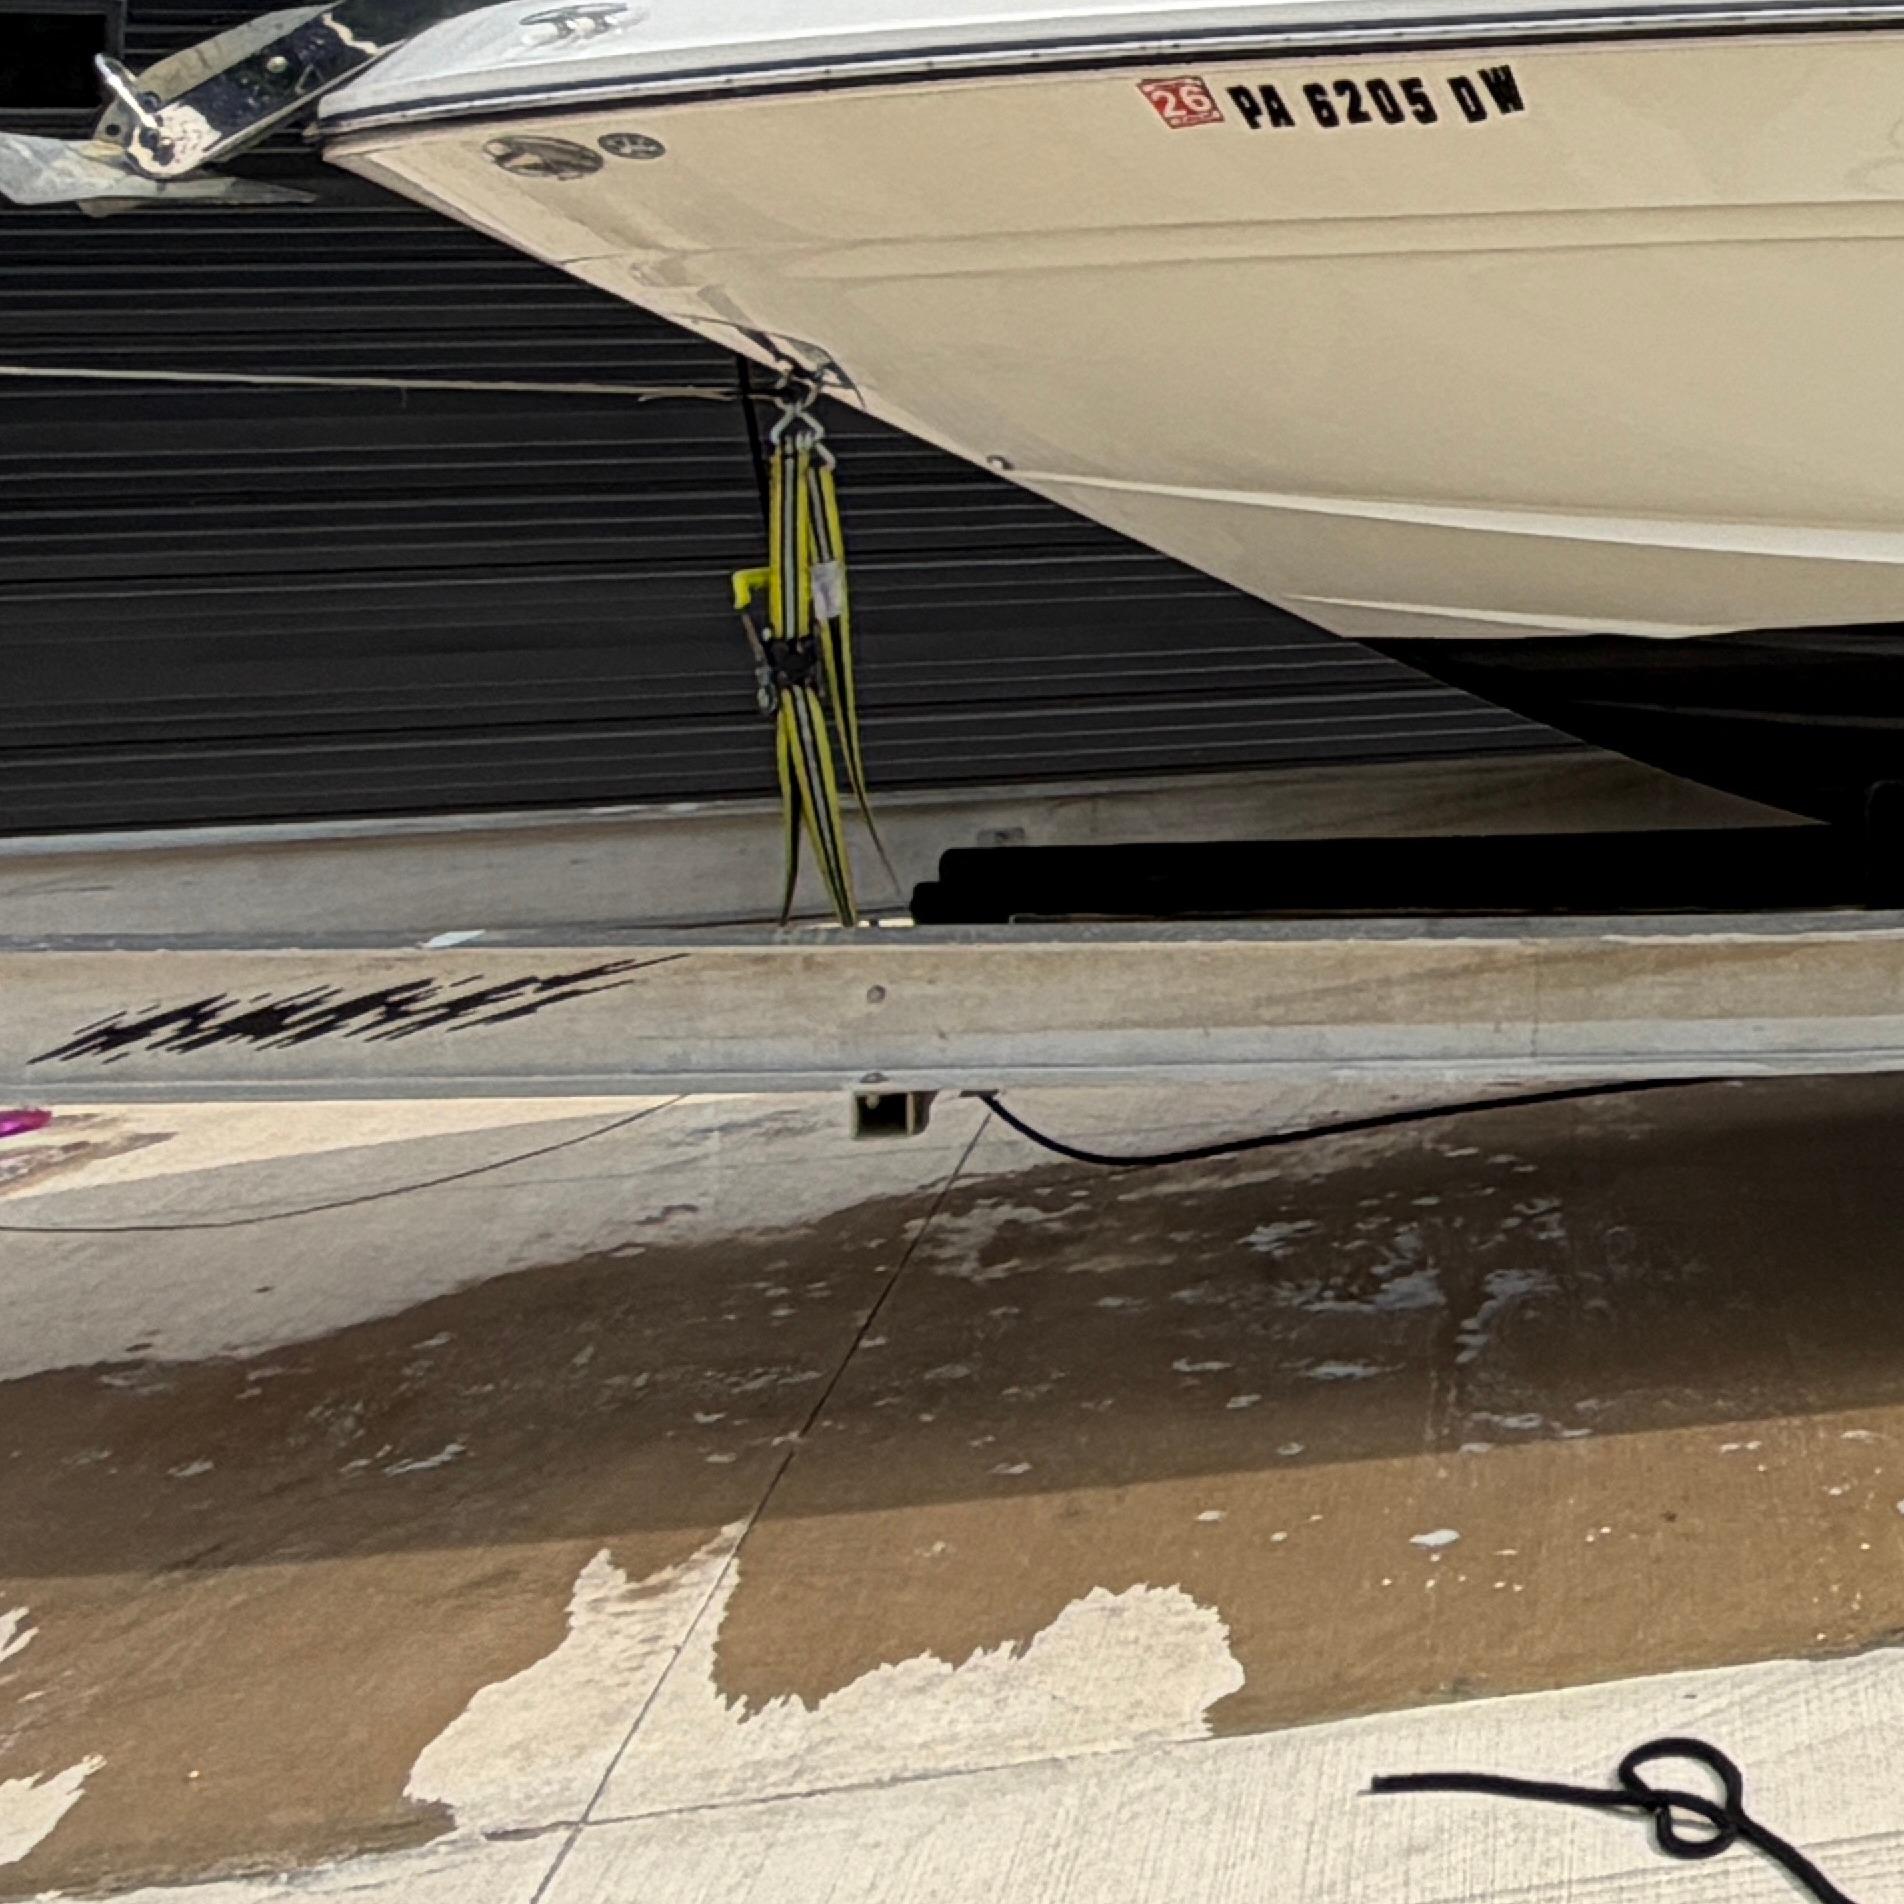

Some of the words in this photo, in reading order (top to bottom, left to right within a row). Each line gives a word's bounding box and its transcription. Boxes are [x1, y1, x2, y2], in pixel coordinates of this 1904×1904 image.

[1151, 86, 1212, 117] 26
[1226, 84, 1296, 129] PA
[1302, 77, 1438, 128] 6205
